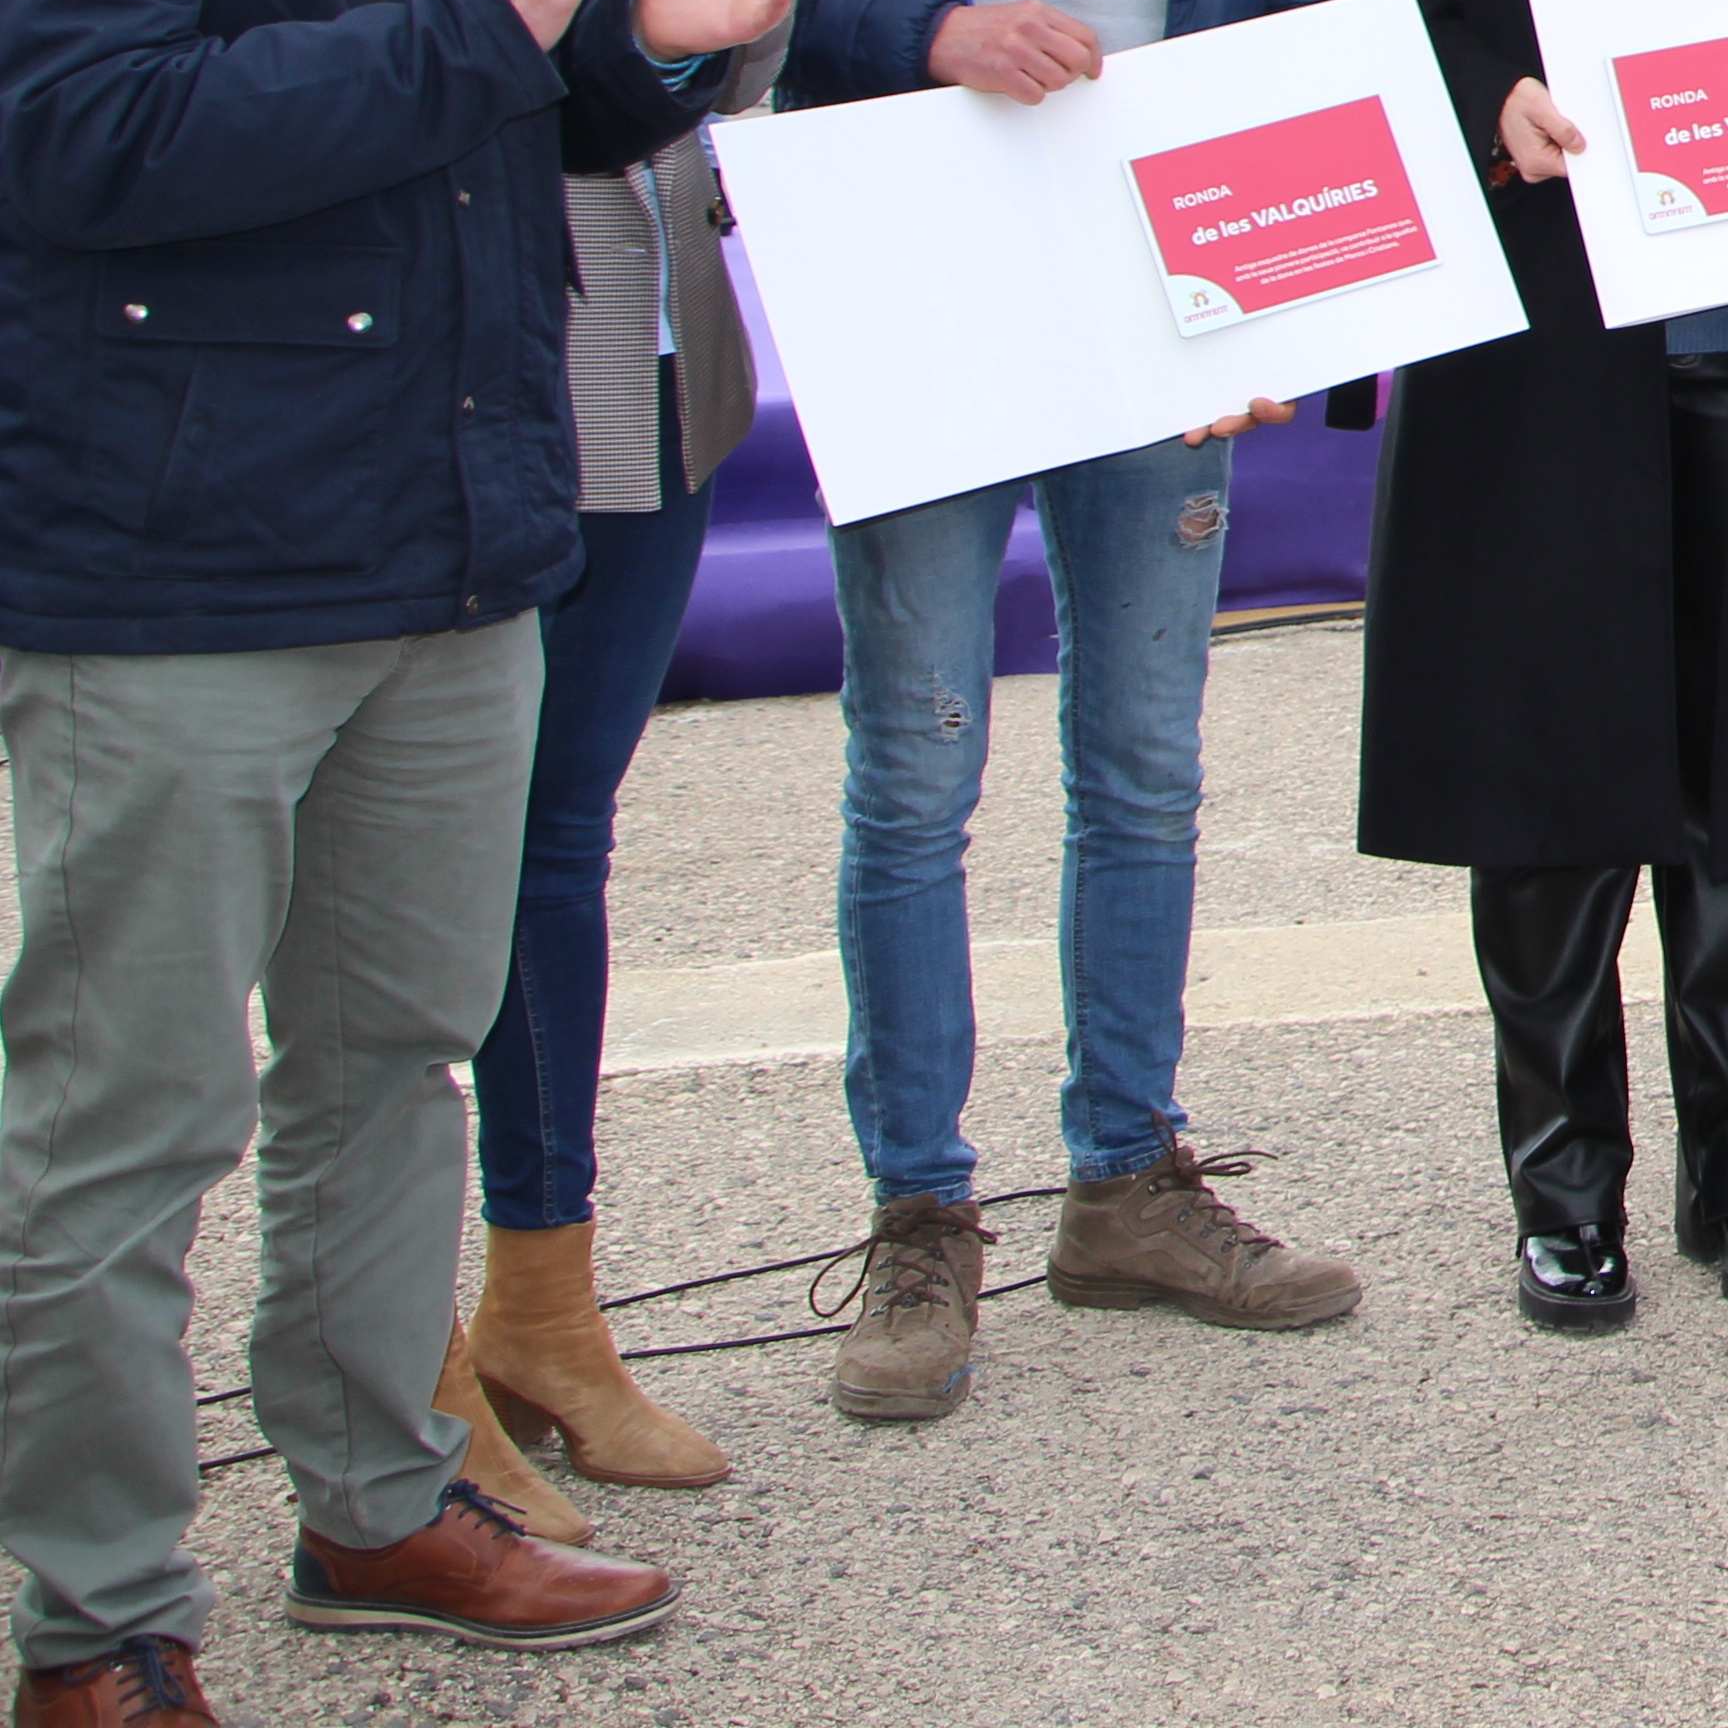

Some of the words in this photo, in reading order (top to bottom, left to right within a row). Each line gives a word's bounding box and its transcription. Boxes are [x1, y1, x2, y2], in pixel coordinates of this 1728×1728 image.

[1649, 88, 1708, 109] RONDA
[1664, 127, 1690, 145] de
[1692, 123, 1723, 139] les
[1172, 184, 1232, 209] RONDA
[1192, 226, 1218, 244] de
[1218, 218, 1251, 236] les
[1250, 179, 1378, 226] VALQUÍRIES
